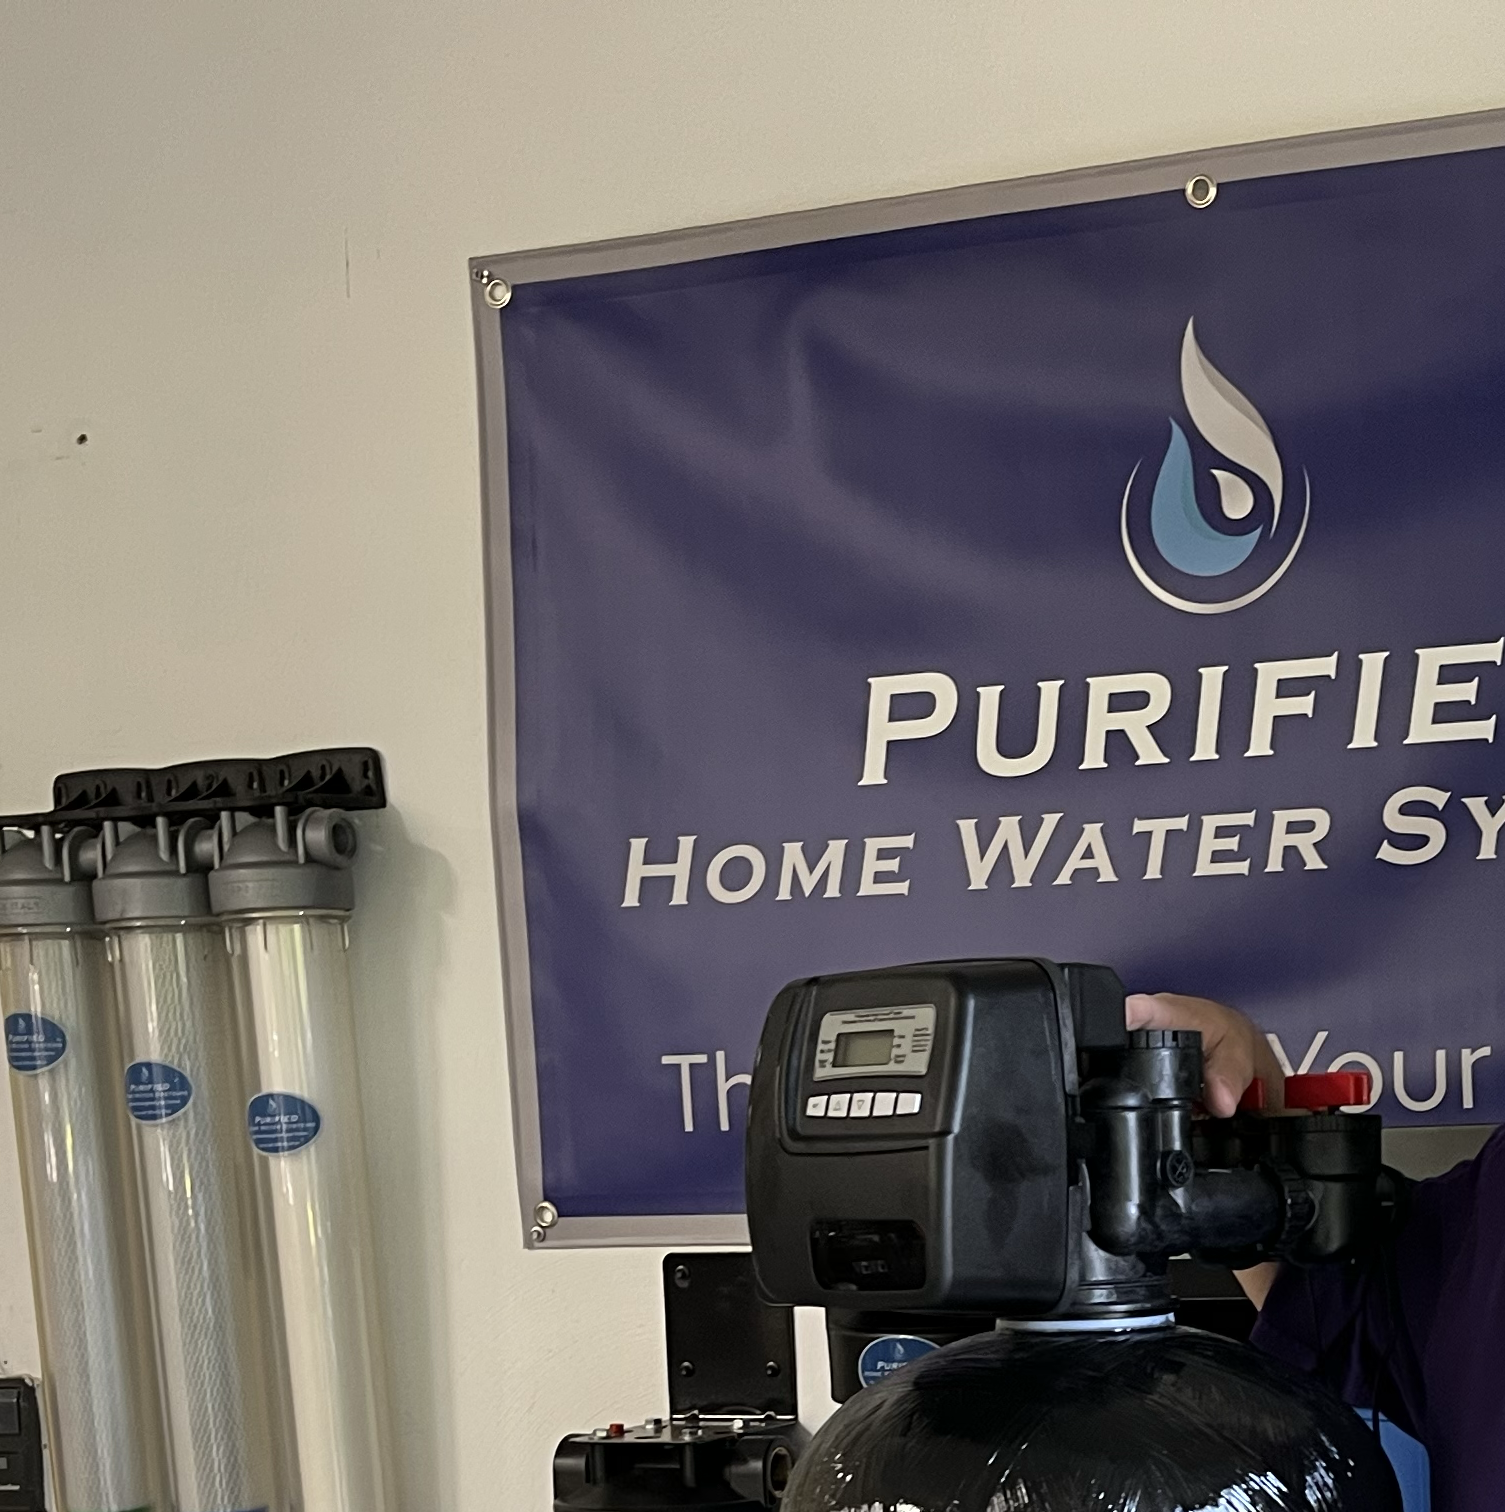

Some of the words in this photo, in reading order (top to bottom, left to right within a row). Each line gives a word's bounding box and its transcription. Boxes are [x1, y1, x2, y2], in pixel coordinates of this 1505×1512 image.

[621, 832, 916, 907] HOME
[956, 807, 1331, 890] WATER
[1265, 1031, 1492, 1114] Your
